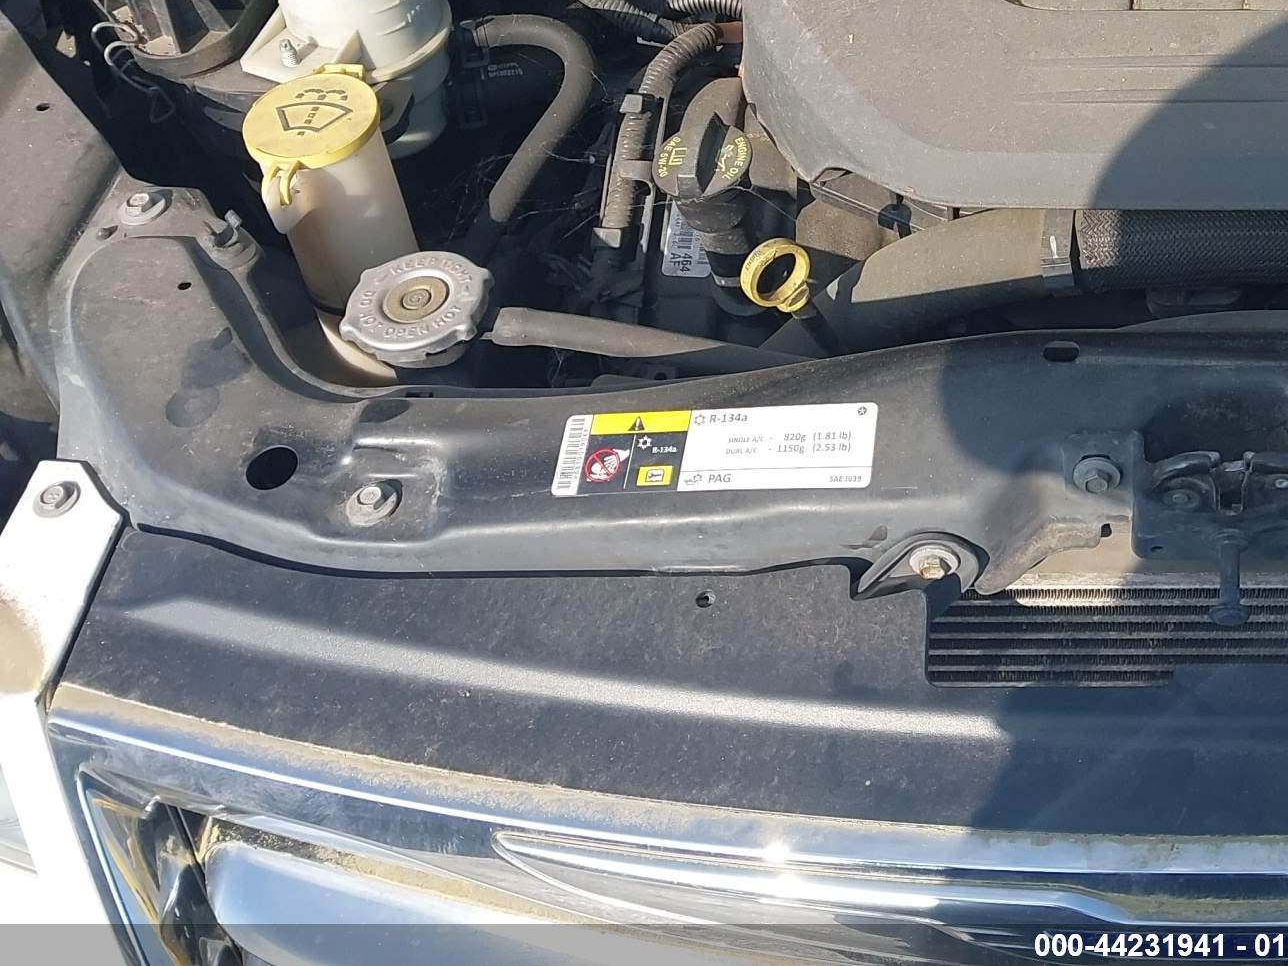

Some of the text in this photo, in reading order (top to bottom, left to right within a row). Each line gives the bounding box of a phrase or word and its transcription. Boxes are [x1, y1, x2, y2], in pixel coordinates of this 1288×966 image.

[721, 136, 747, 180] ENGINE OIL
[669, 252, 680, 267] AF
[679, 252, 693, 273] 464
[383, 325, 430, 339] OPEN
[432, 304, 463, 329] HOT
[709, 413, 748, 424] R-134a
[783, 433, 806, 443] 820g
[812, 432, 836, 442] (1.81
[838, 431, 852, 441] lb)
[776, 444, 805, 454] 1150g
[812, 444, 836, 453] (2.53
[838, 442, 852, 453] lb)
[708, 473, 732, 483] PAG
[829, 475, 843, 483] SAE
